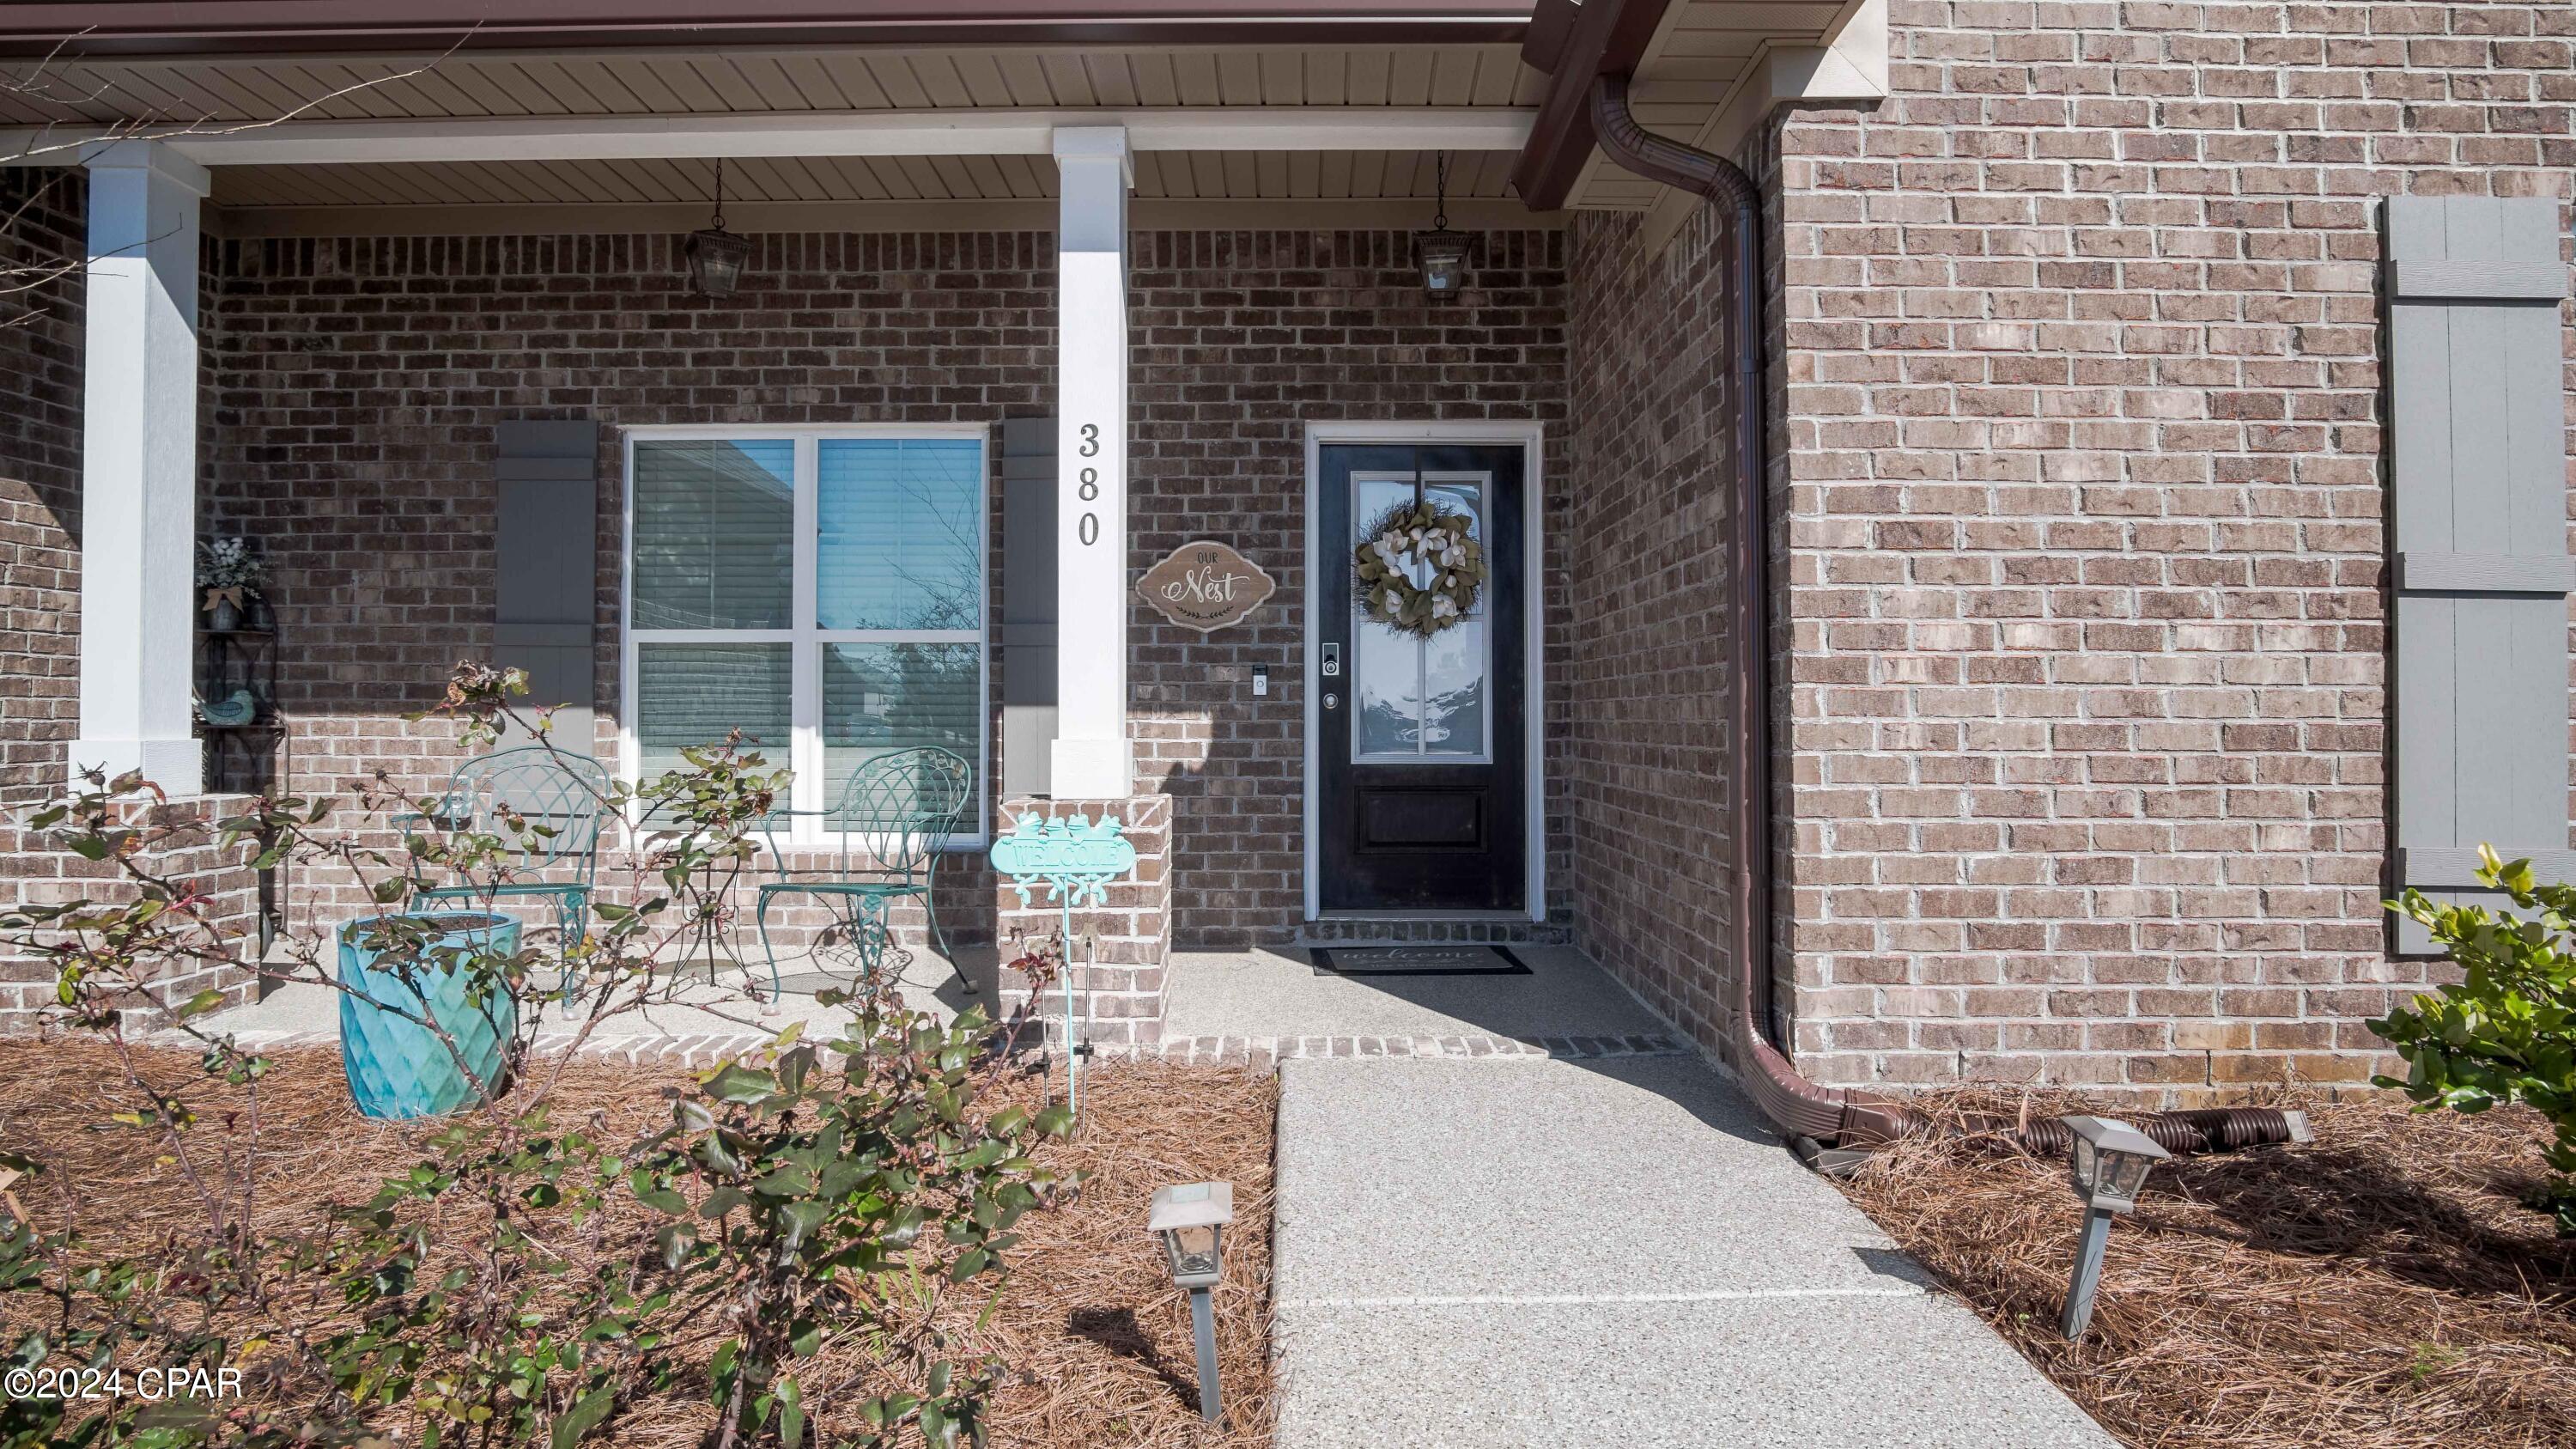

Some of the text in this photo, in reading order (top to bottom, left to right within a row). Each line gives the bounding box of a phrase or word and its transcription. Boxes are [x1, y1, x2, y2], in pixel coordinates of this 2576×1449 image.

[1078, 423, 1099, 545] 380
[1197, 551, 1218, 564] OUR
[1160, 565, 1250, 603] Nest
